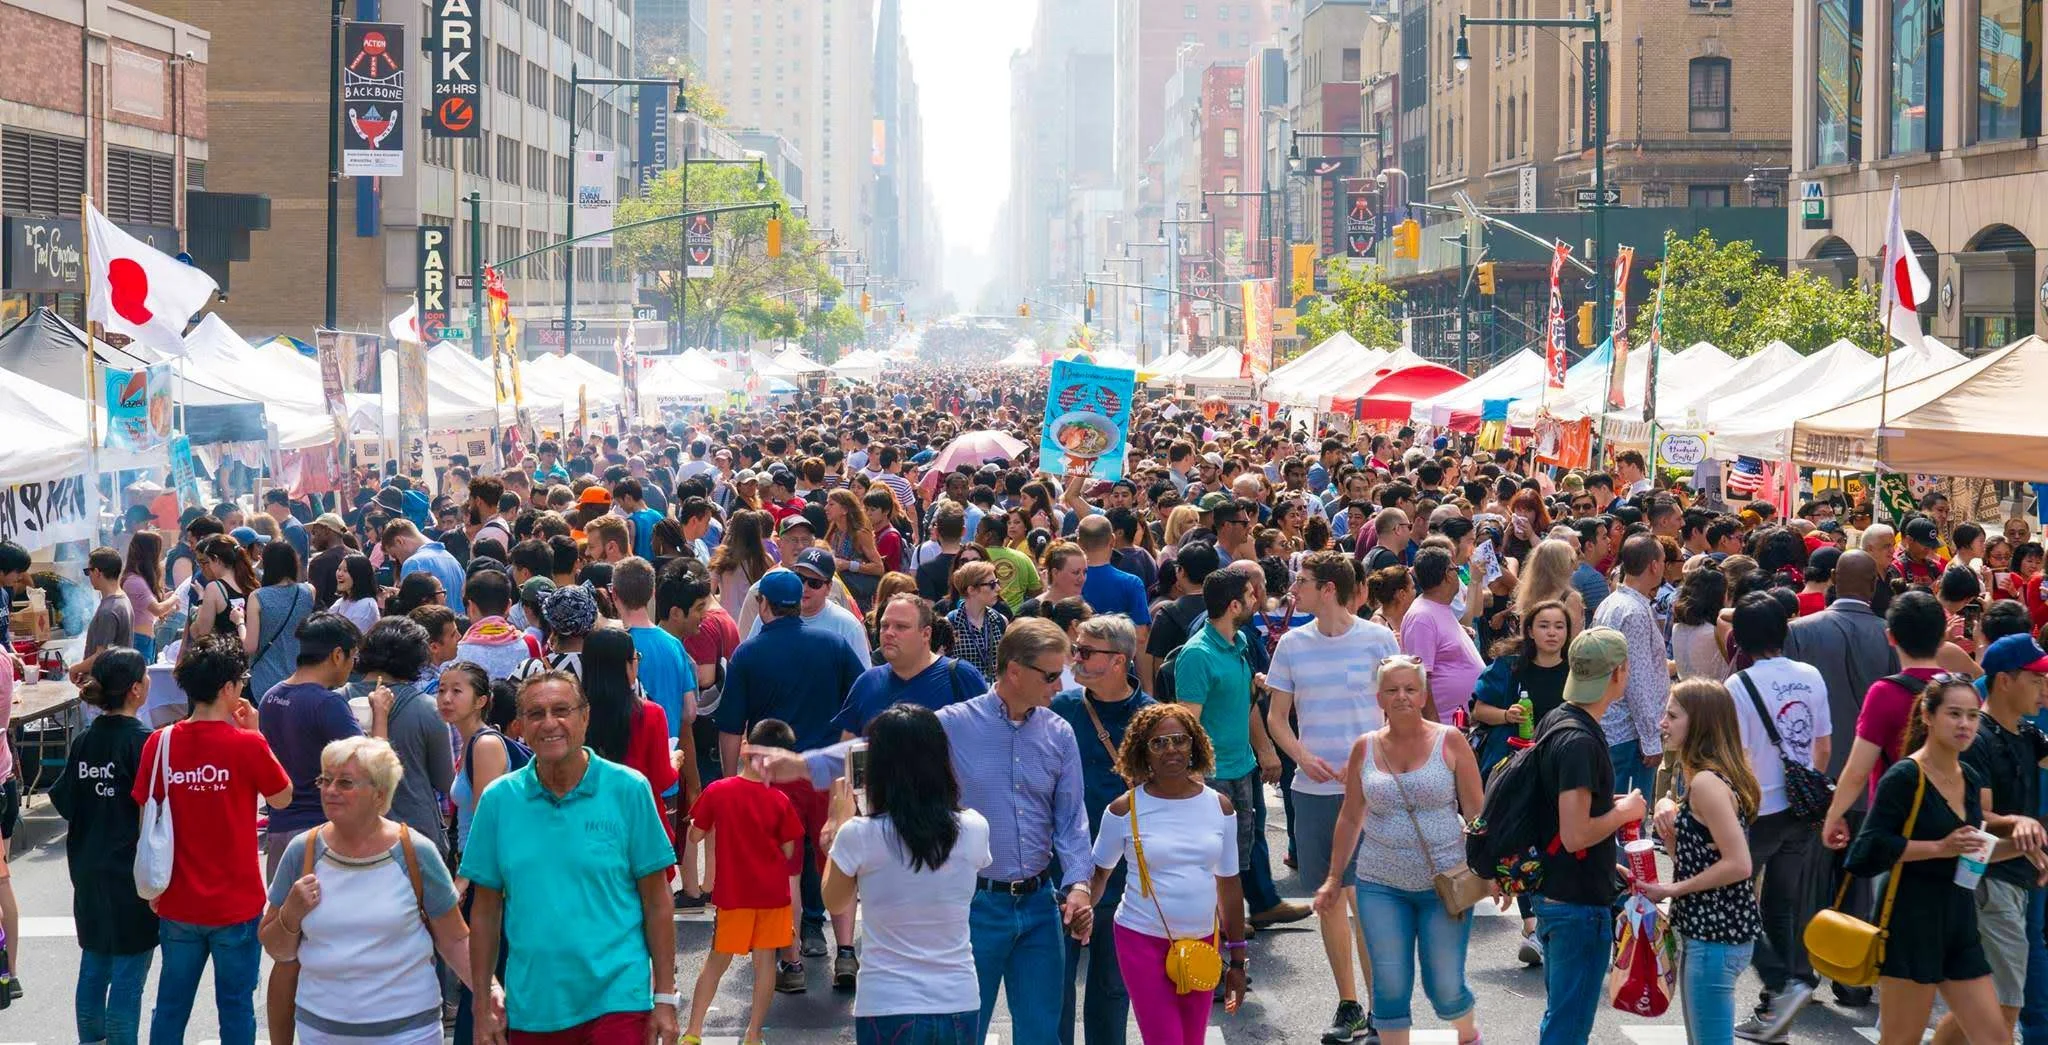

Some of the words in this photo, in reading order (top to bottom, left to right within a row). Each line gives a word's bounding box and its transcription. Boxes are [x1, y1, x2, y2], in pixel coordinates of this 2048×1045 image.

[363, 39, 386, 48] ACTION
[441, 0, 472, 80] ARK
[345, 86, 403, 100] BACKBONE
[436, 83, 450, 94] 24
[453, 83, 477, 94] HRS
[424, 230, 444, 310] PARK
[447, 329, 457, 337] 49
[808, 550, 820, 562] NY
[1772, 681, 1812, 701] Japan
